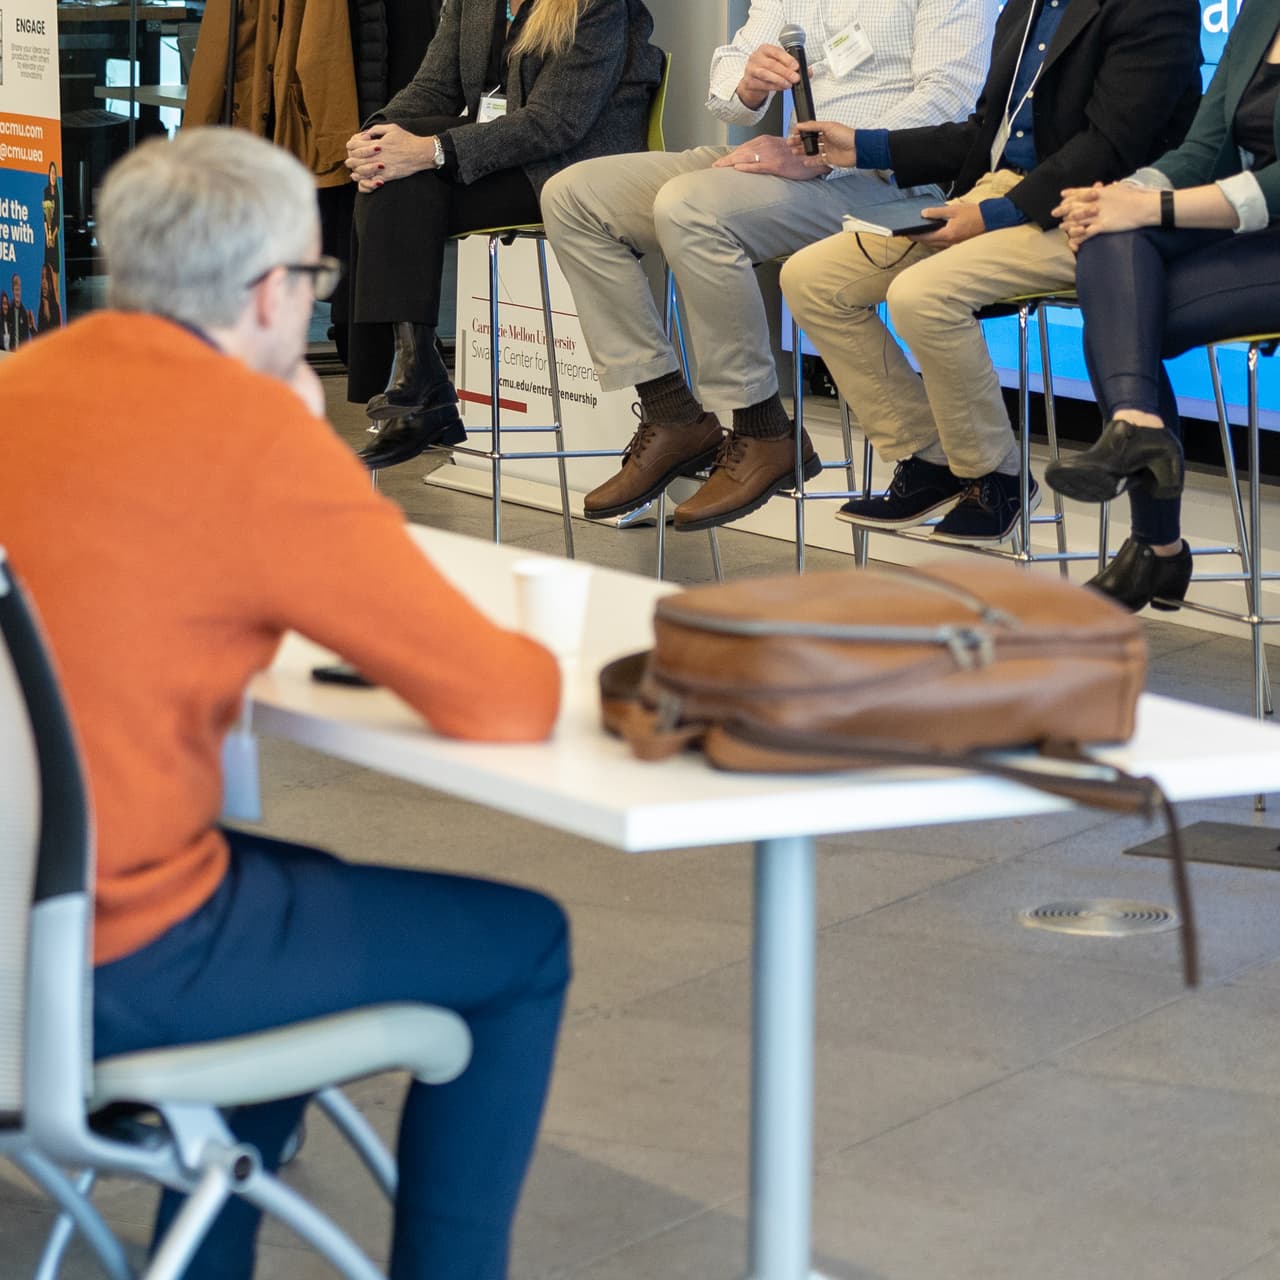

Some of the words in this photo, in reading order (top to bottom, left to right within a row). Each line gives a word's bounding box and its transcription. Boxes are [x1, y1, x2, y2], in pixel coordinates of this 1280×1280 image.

[15, 17, 46, 36] ENGAGE
[0, 142, 44, 162] @cmu.uea
[10, 200, 29, 220] the
[10, 222, 34, 244] with
[509, 324, 536, 342] Mellon
[503, 346, 533, 368] Center
[535, 352, 547, 371] for
